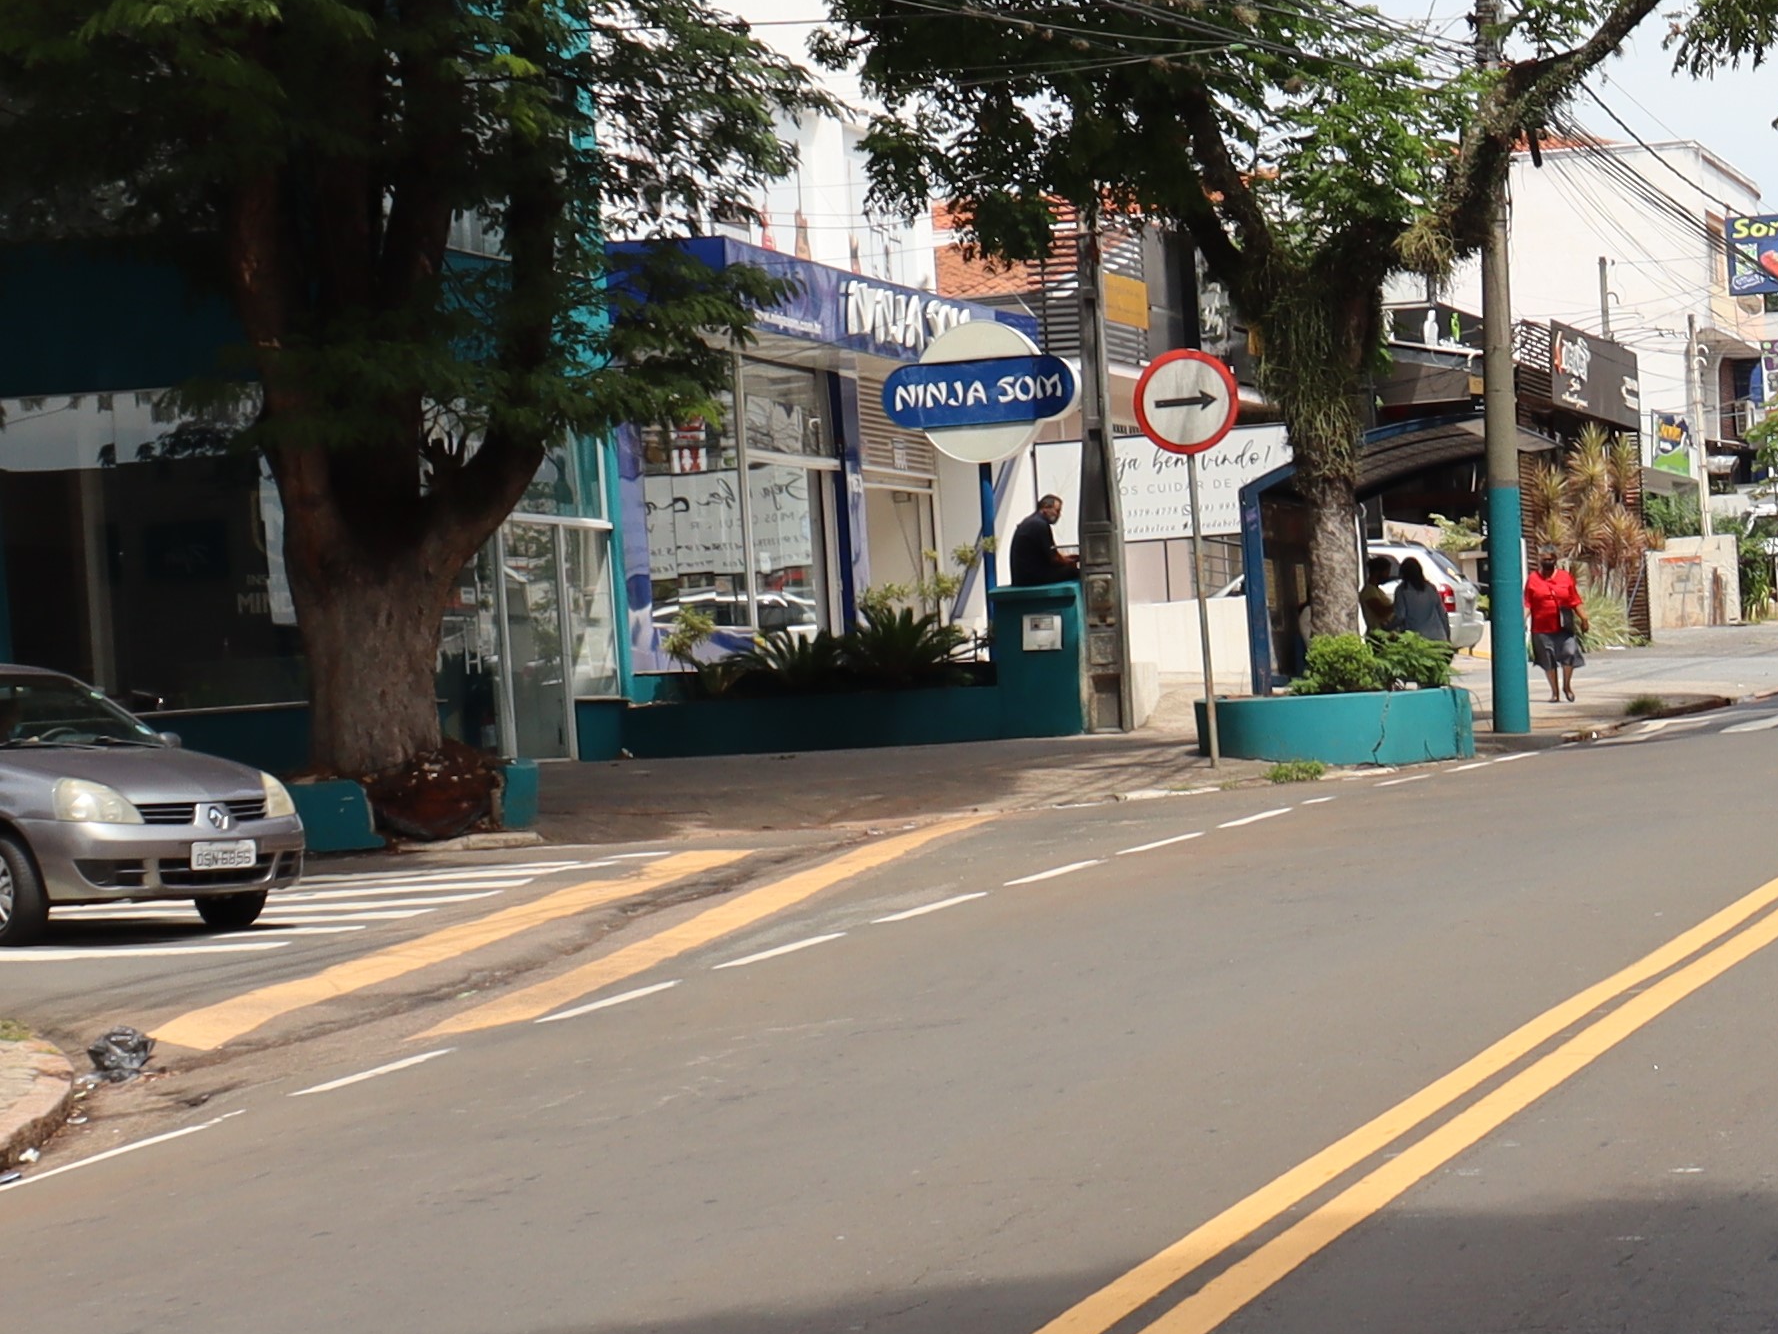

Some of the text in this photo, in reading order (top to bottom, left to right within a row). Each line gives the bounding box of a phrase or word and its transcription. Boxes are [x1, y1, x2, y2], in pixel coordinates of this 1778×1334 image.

[842, 280, 924, 350] NINJA
[895, 373, 1063, 412] NINJA SOM
[1213, 479, 1232, 489] DE
